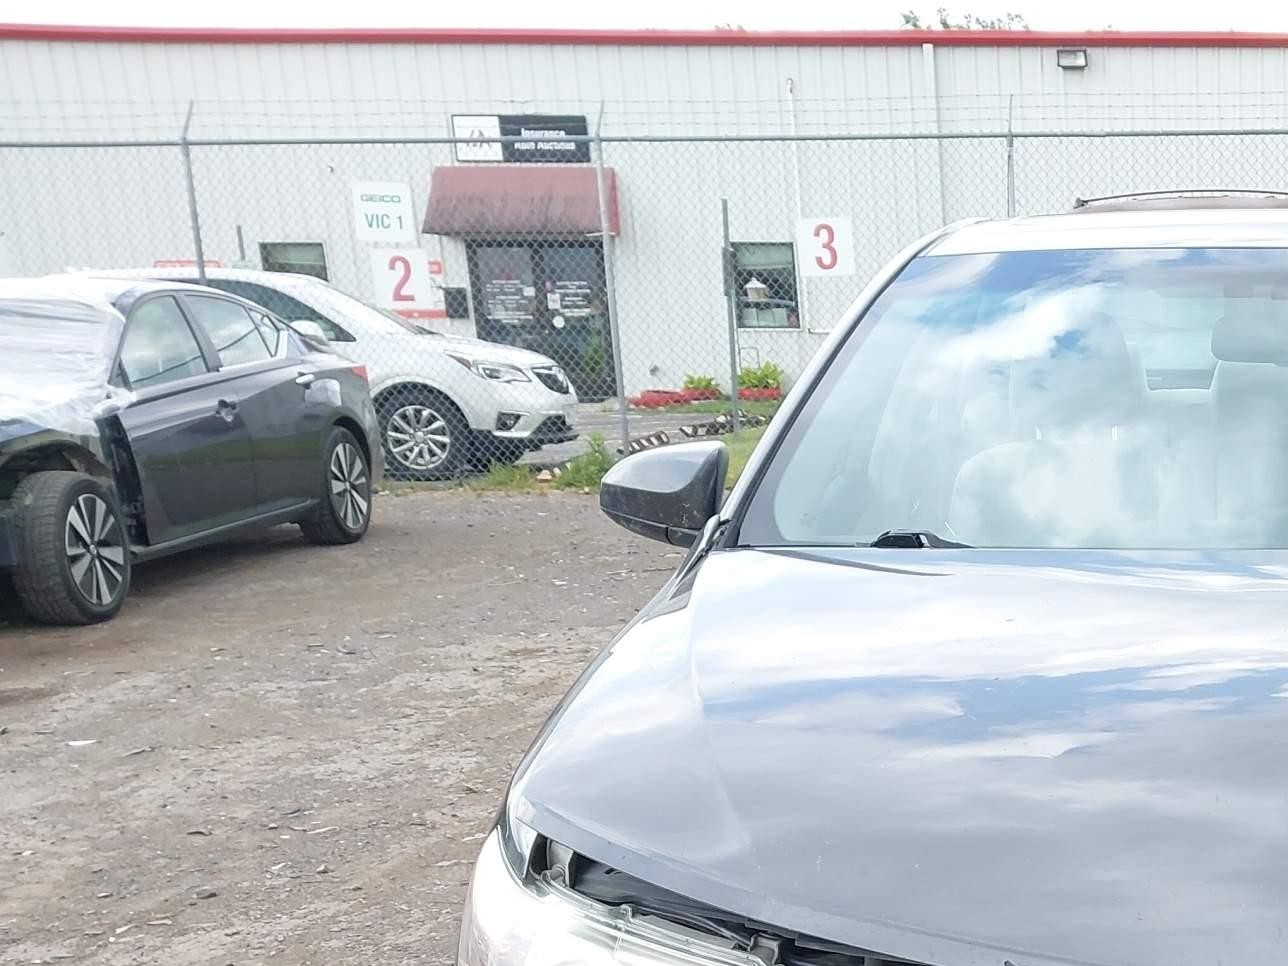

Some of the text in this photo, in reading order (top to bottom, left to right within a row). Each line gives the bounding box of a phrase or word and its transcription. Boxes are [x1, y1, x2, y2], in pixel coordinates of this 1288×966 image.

[360, 193, 401, 203] GEICO
[364, 213, 404, 229] VIC 1
[813, 223, 838, 270] 3
[388, 255, 416, 302] 2
